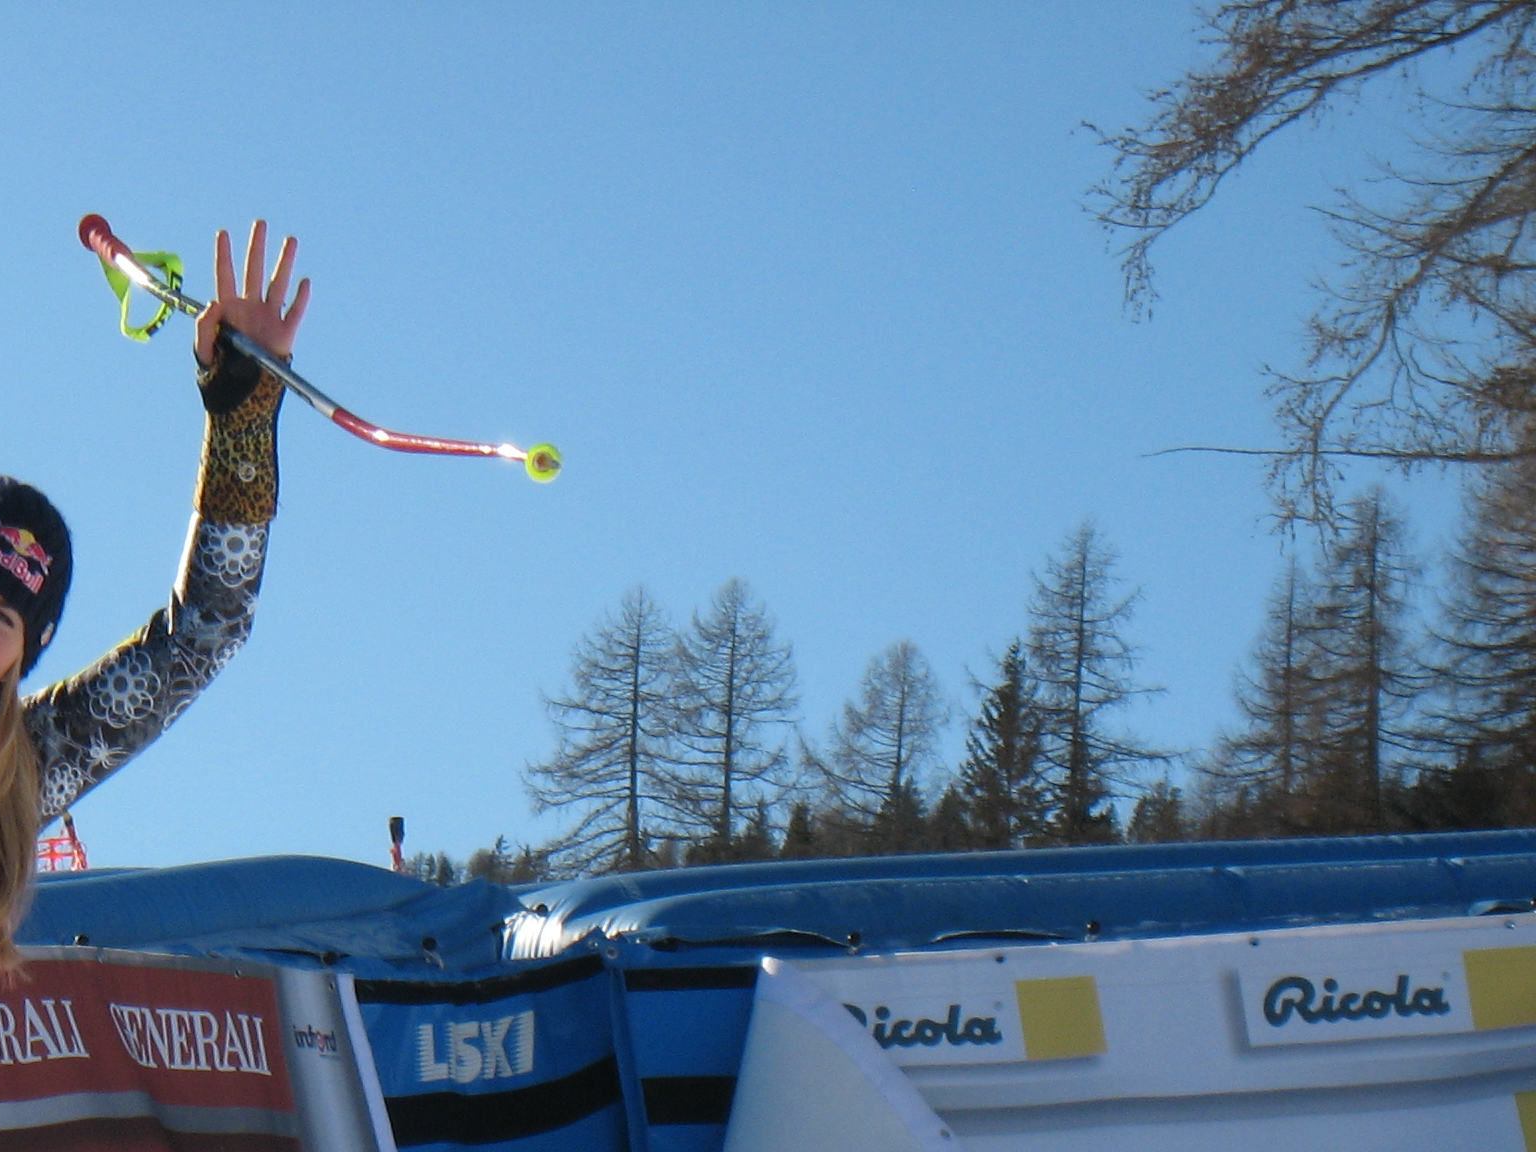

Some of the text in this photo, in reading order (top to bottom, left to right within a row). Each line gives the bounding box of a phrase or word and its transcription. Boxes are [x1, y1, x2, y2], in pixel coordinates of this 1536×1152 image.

[842, 1003, 1002, 1049] icola
[1264, 973, 1452, 1029] Ricola
[109, 1002, 272, 1075] GENERALI
